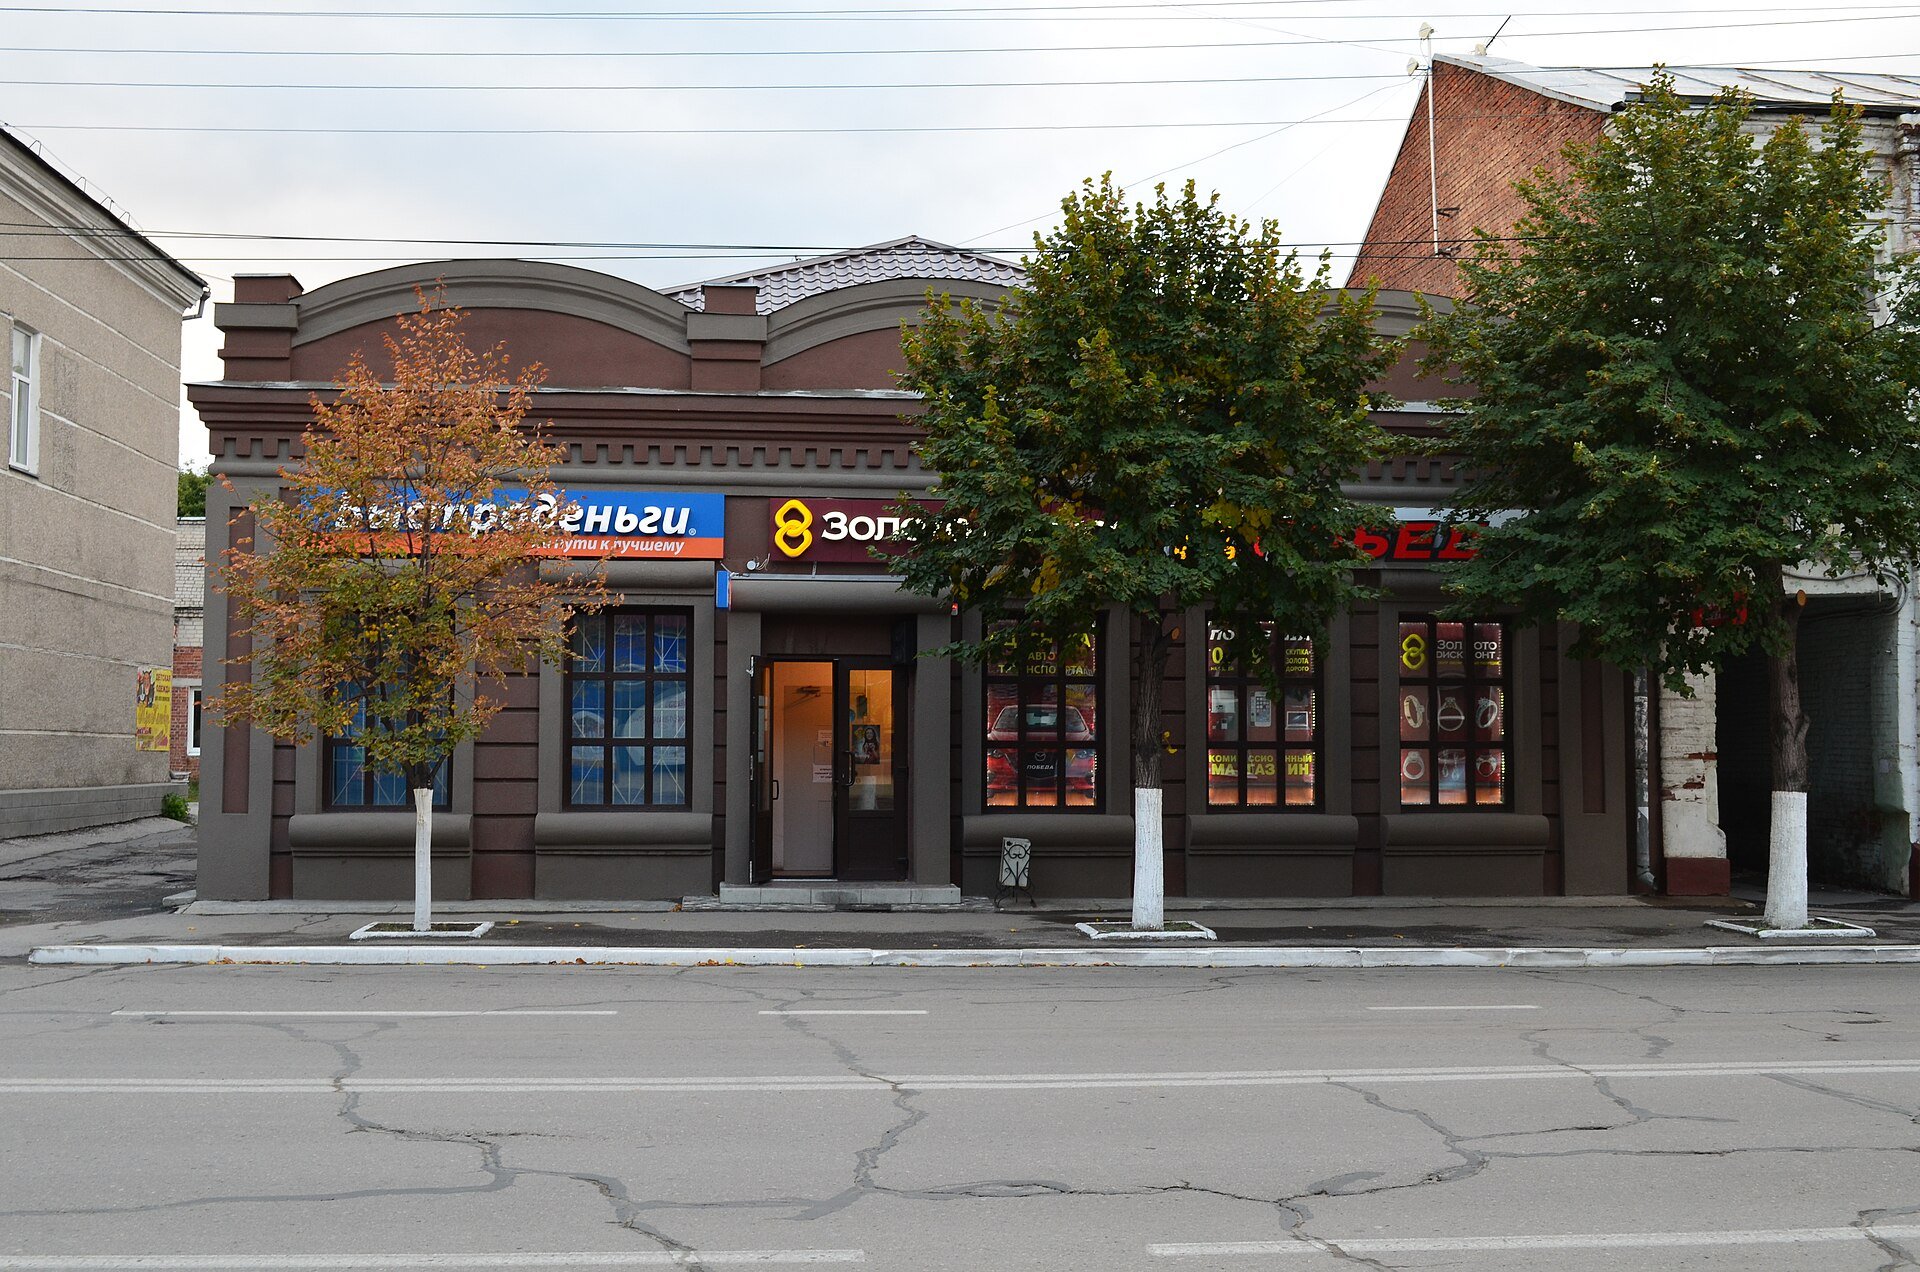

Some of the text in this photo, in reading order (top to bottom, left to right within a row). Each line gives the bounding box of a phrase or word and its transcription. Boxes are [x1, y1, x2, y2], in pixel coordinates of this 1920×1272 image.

[600, 540, 610, 550] к
[1028, 651, 1057, 661] АВТО
[1285, 648, 1309, 656] СКУПКА
[1285, 657, 1309, 665] ЗОЛОТА
[1208, 752, 1313, 763] КОМИССИОННЫЙ
[1211, 763, 1310, 776] МАГАЗИН
